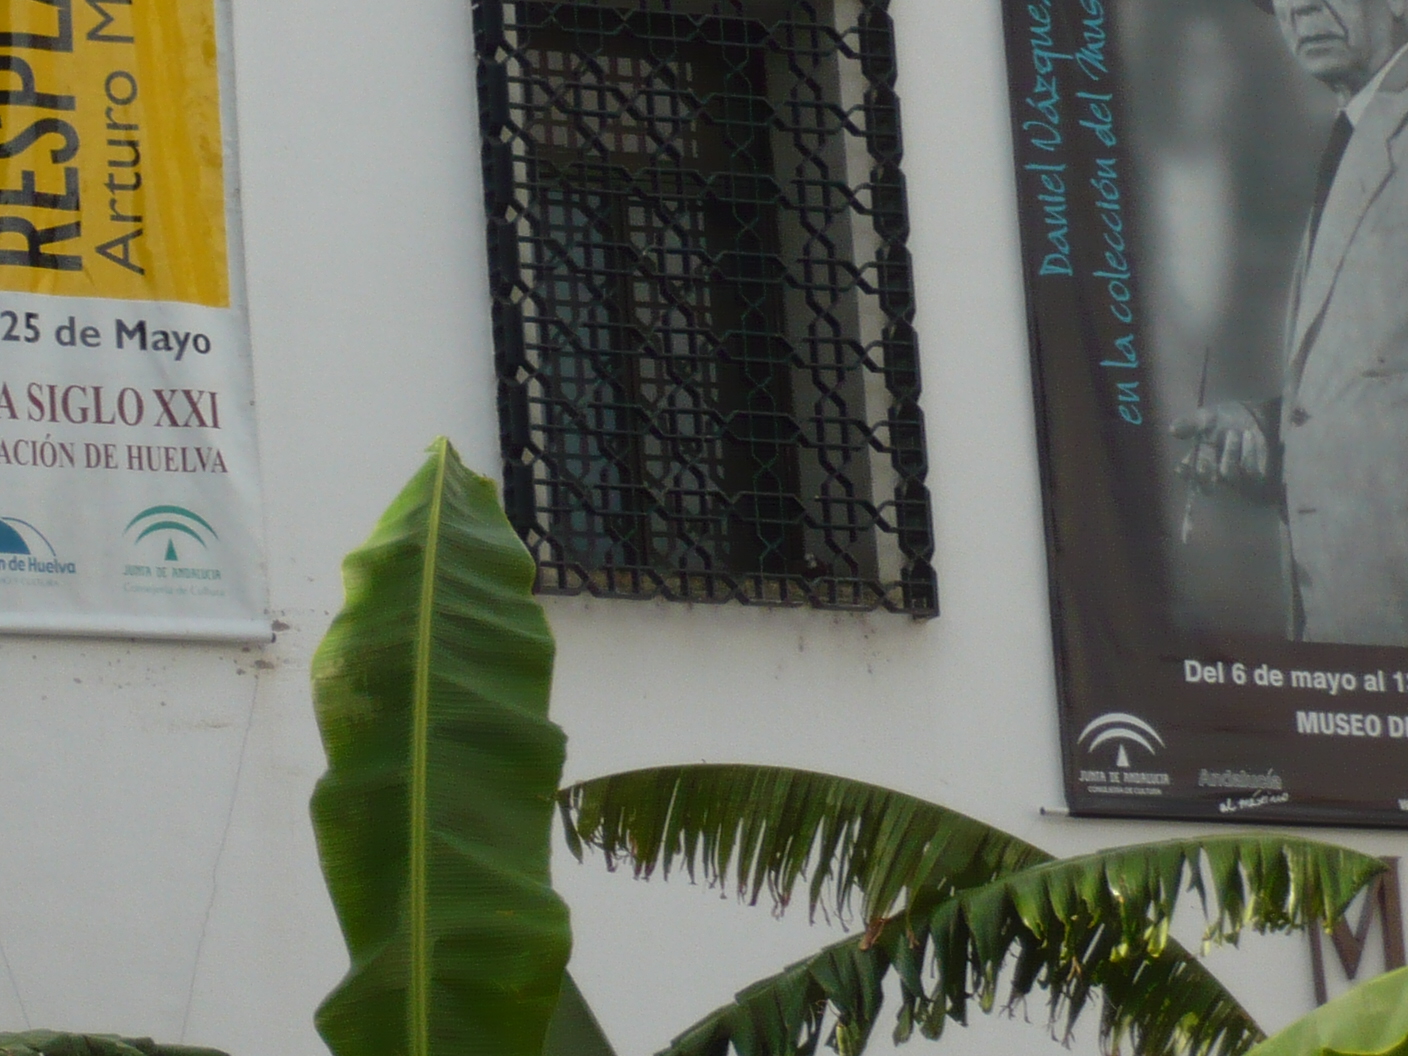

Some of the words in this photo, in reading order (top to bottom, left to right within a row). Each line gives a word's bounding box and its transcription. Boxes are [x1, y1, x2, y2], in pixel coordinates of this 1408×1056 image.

[1075, 91, 1117, 149] del
[95, 69, 145, 276] Arturo
[1024, 163, 1074, 277] Daniel
[1091, 157, 1133, 323] colección
[0, 310, 42, 344] 25
[55, 316, 101, 348] de
[115, 318, 211, 361] Mayo
[1099, 333, 1140, 369] la
[26, 381, 145, 427] SIGLO
[152, 388, 222, 430] XXI
[1115, 381, 1143, 426] en
[84, 441, 119, 470] DE
[127, 445, 229, 474] HUELVA
[8, 555, 26, 572] de
[28, 557, 77, 574] Huelva
[1184, 659, 1225, 684] Del
[1231, 662, 1247, 685] 6
[1254, 664, 1284, 688] de
[1291, 669, 1357, 695] mayo
[1363, 669, 1386, 693] al
[1296, 710, 1382, 737] MUSEO
